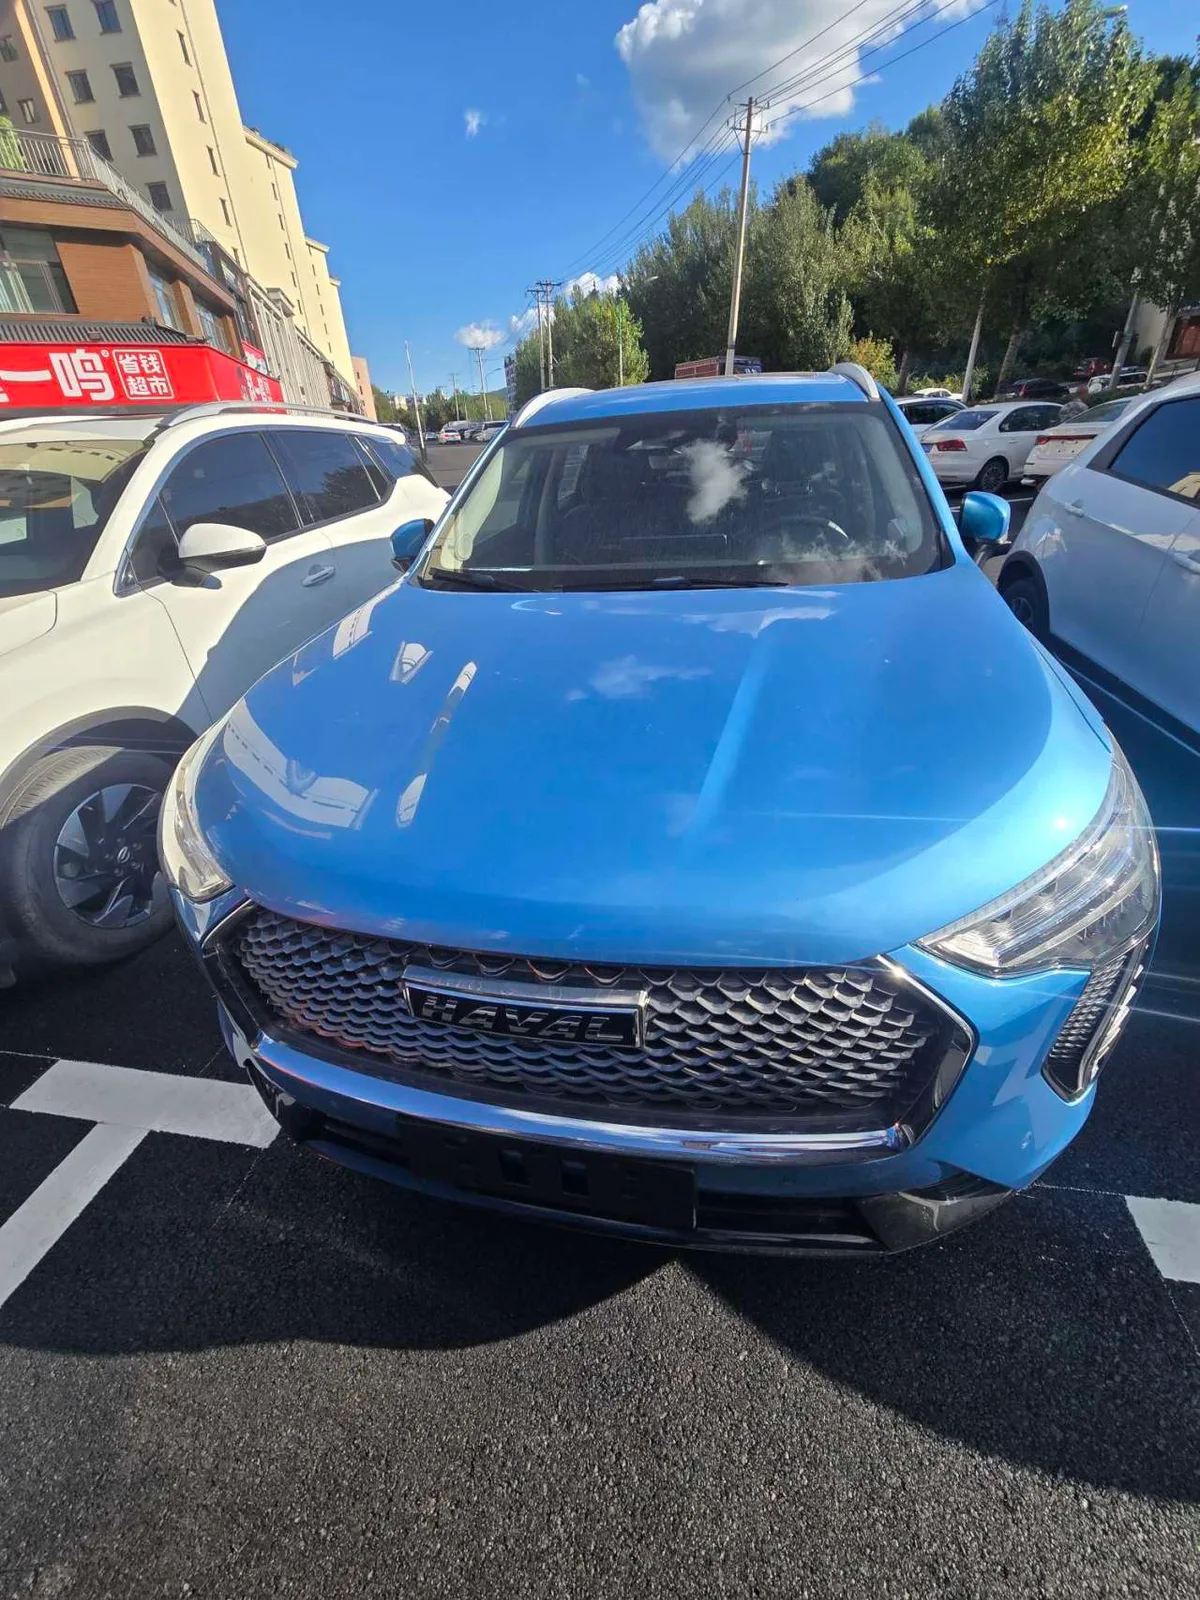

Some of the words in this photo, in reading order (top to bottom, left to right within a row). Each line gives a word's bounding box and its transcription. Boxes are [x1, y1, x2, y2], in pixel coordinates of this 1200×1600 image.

[0, 349, 115, 402] 一鸣
[119, 353, 161, 374] 省钱
[127, 375, 169, 395] 超市
[421, 996, 624, 1042] HAVAL
